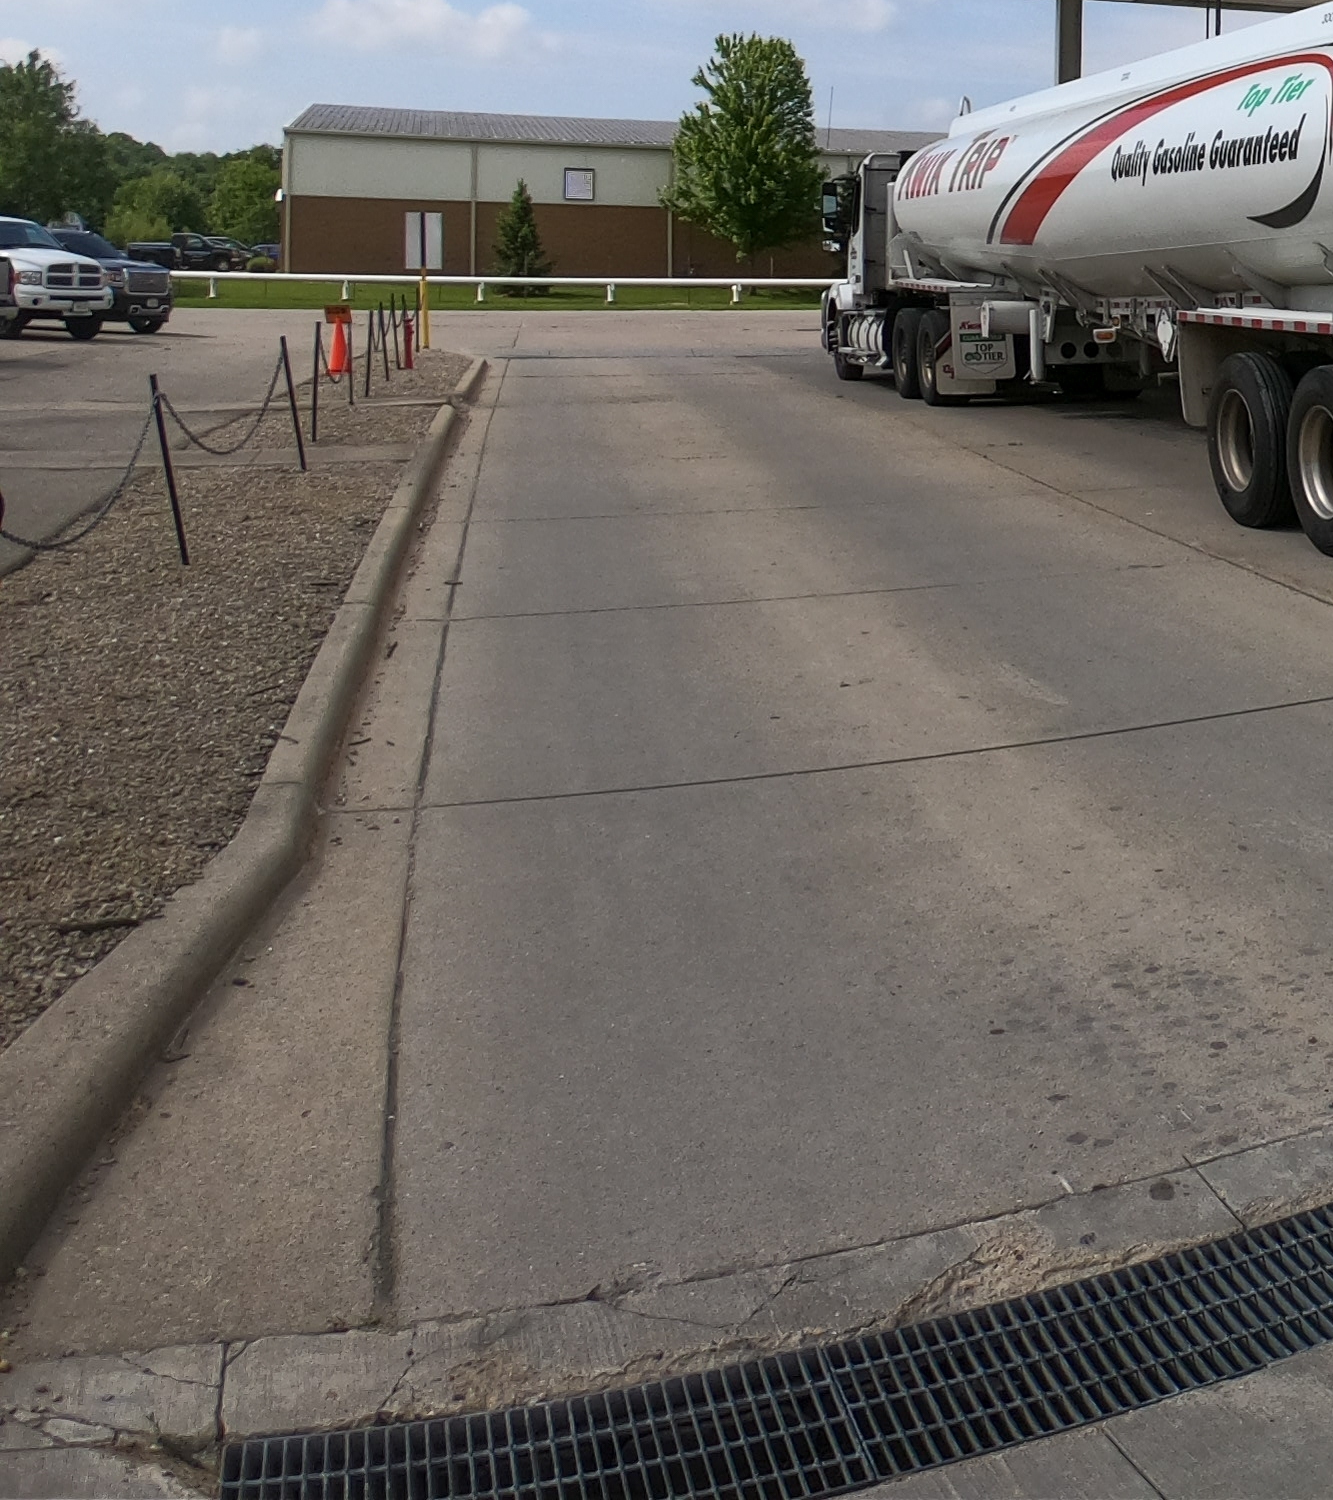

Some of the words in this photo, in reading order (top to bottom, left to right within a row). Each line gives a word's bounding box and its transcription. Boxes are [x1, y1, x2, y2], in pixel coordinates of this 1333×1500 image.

[1236, 83, 1272, 117] Top
[1271, 73, 1315, 105] Tier
[1111, 140, 1150, 186] Quality
[1152, 131, 1206, 175] Gasoline
[1209, 113, 1307, 169] Guaranteed
